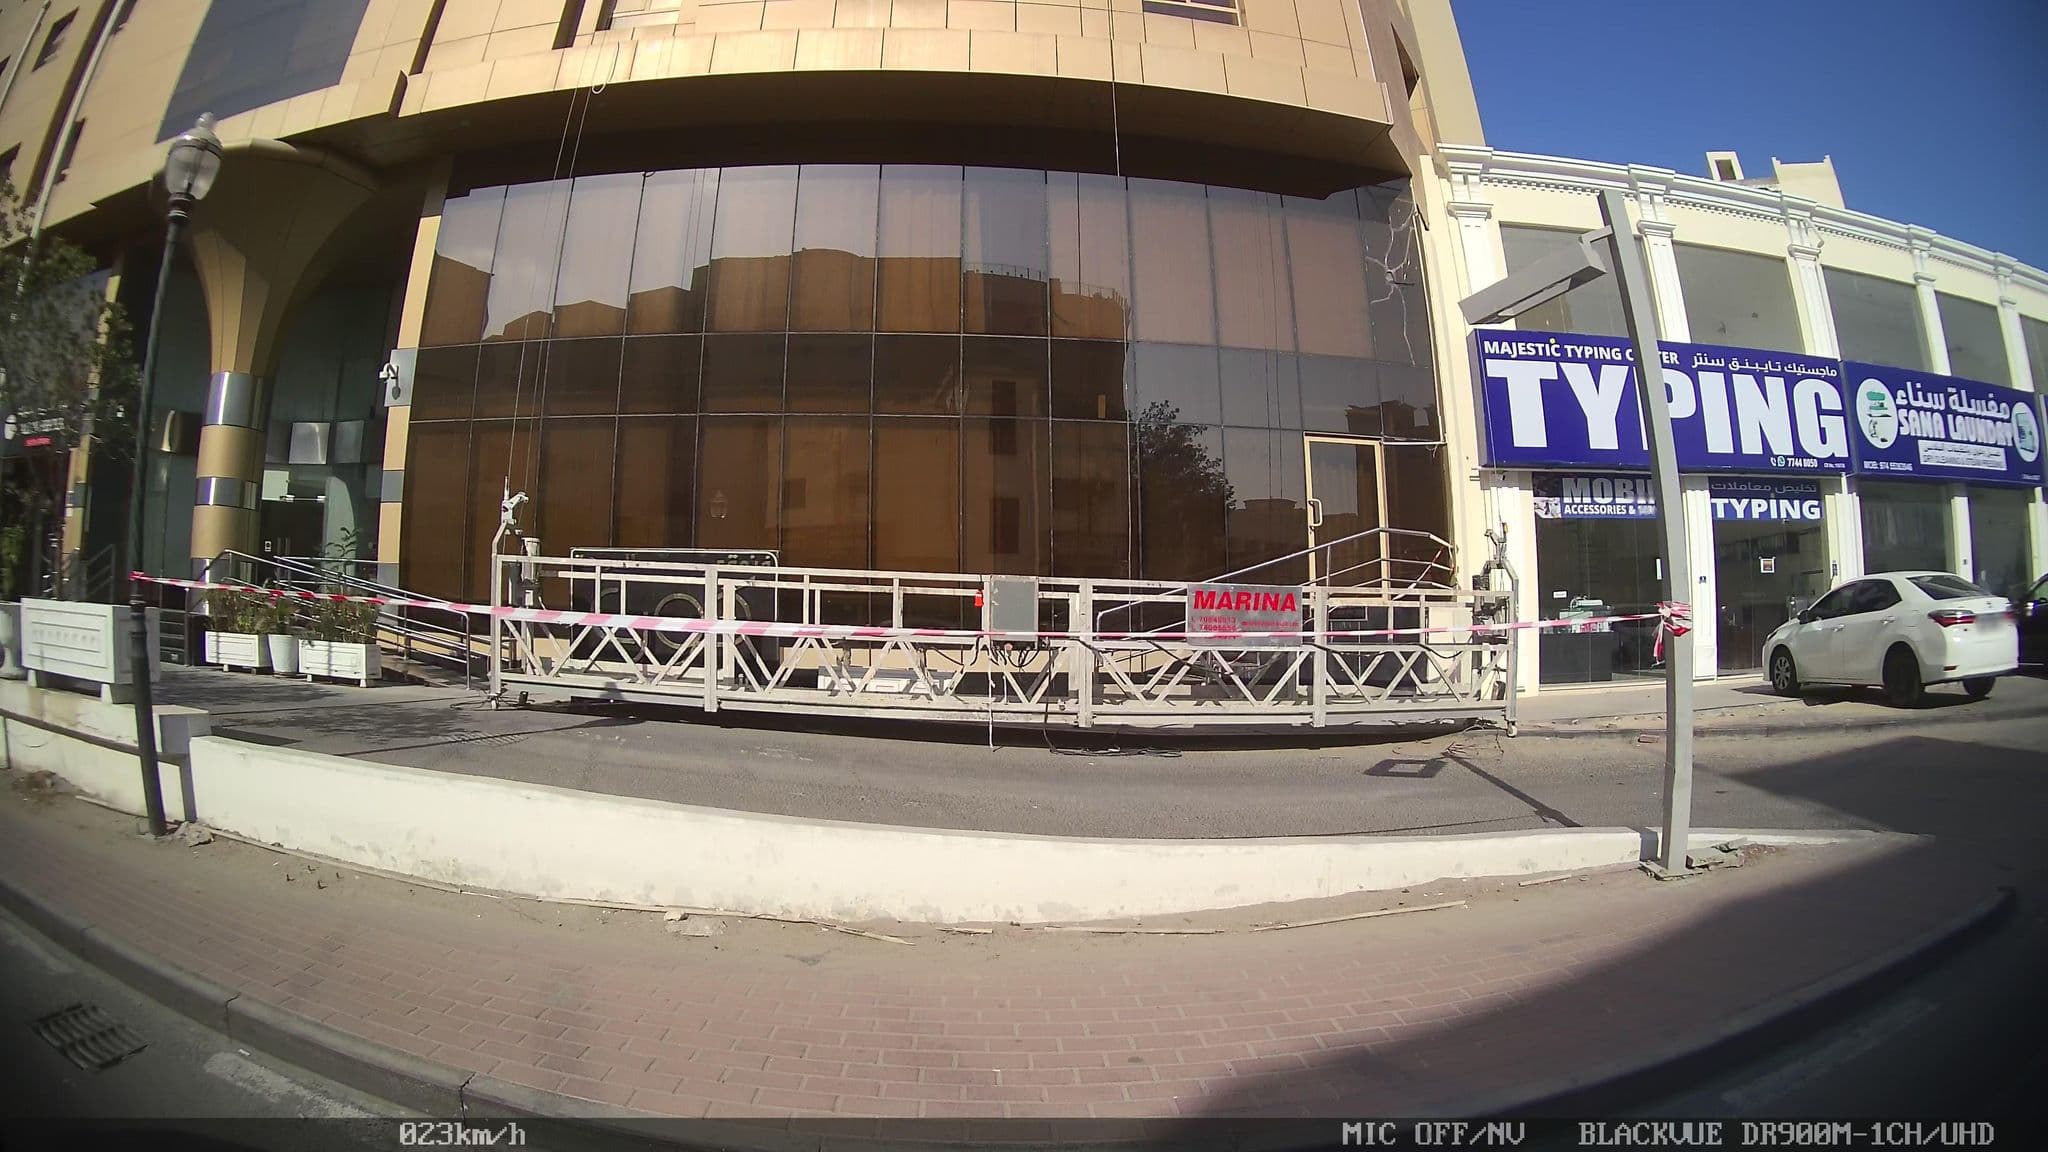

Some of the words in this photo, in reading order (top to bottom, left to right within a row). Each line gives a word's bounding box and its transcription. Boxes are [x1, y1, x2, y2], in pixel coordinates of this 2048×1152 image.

[1483, 341, 1560, 358] MAJESTIC
[1564, 345, 1622, 361] TYPING
[1626, 349, 1680, 364] CER
[1692, 353, 1725, 368] سنتر
[1784, 362, 1838, 377] ماجستيك
[1896, 381, 1946, 411] سناء
[1947, 386, 2010, 419] مغسلة
[1485, 358, 1849, 458] TYPING
[1898, 408, 1946, 439] SANA
[1564, 504, 1626, 515] ACCESSORIES
[1628, 505, 1636, 515] &
[1710, 498, 1821, 519] TYPING
[1193, 590, 1297, 612] MARINA
